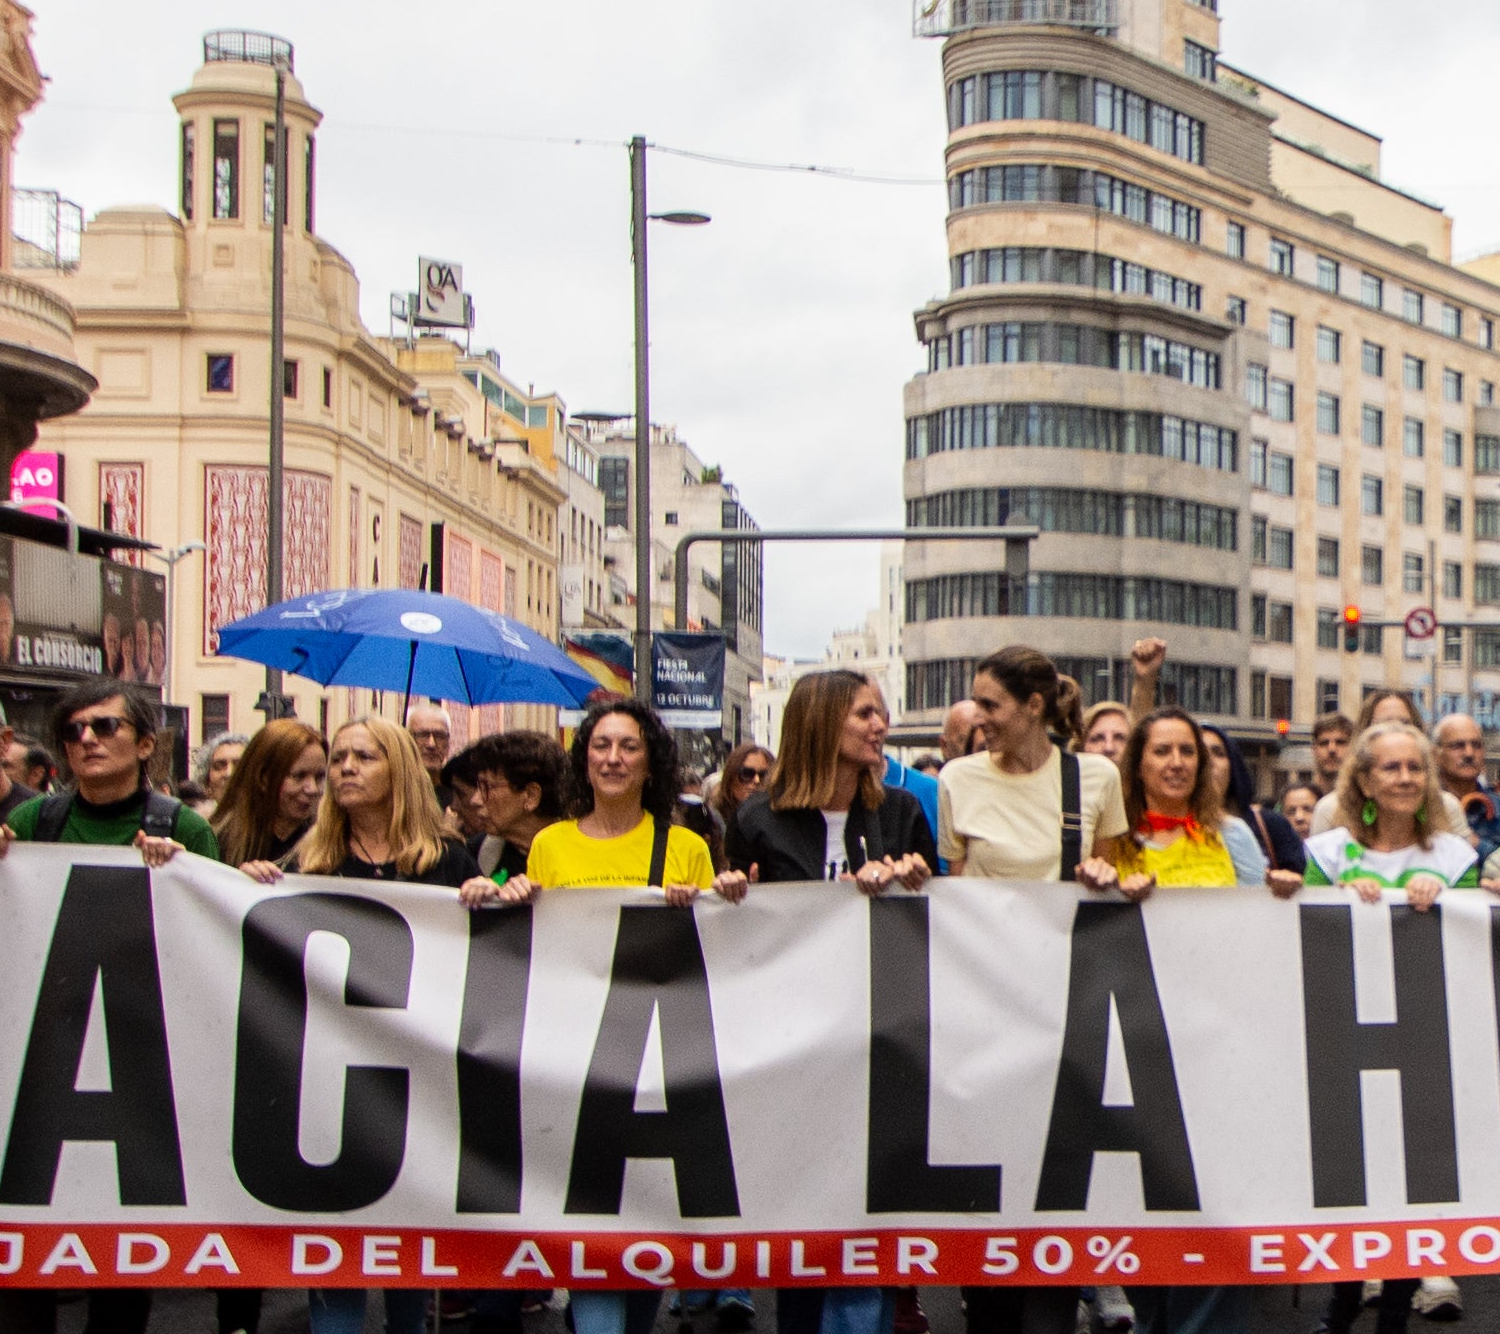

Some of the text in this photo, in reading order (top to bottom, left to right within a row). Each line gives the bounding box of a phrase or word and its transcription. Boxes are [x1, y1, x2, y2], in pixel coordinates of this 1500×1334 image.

[18, 634, 103, 676] EL CONSORCIO
[656, 657, 688, 671] FIESTA
[656, 668, 707, 683] NACIONAL
[669, 692, 714, 708] OCTUBRE
[865, 894, 1202, 1214] LA
[290, 1233, 459, 1277] DEL
[501, 1235, 940, 1286] ALQUILER
[980, 1235, 1142, 1275] 50%
